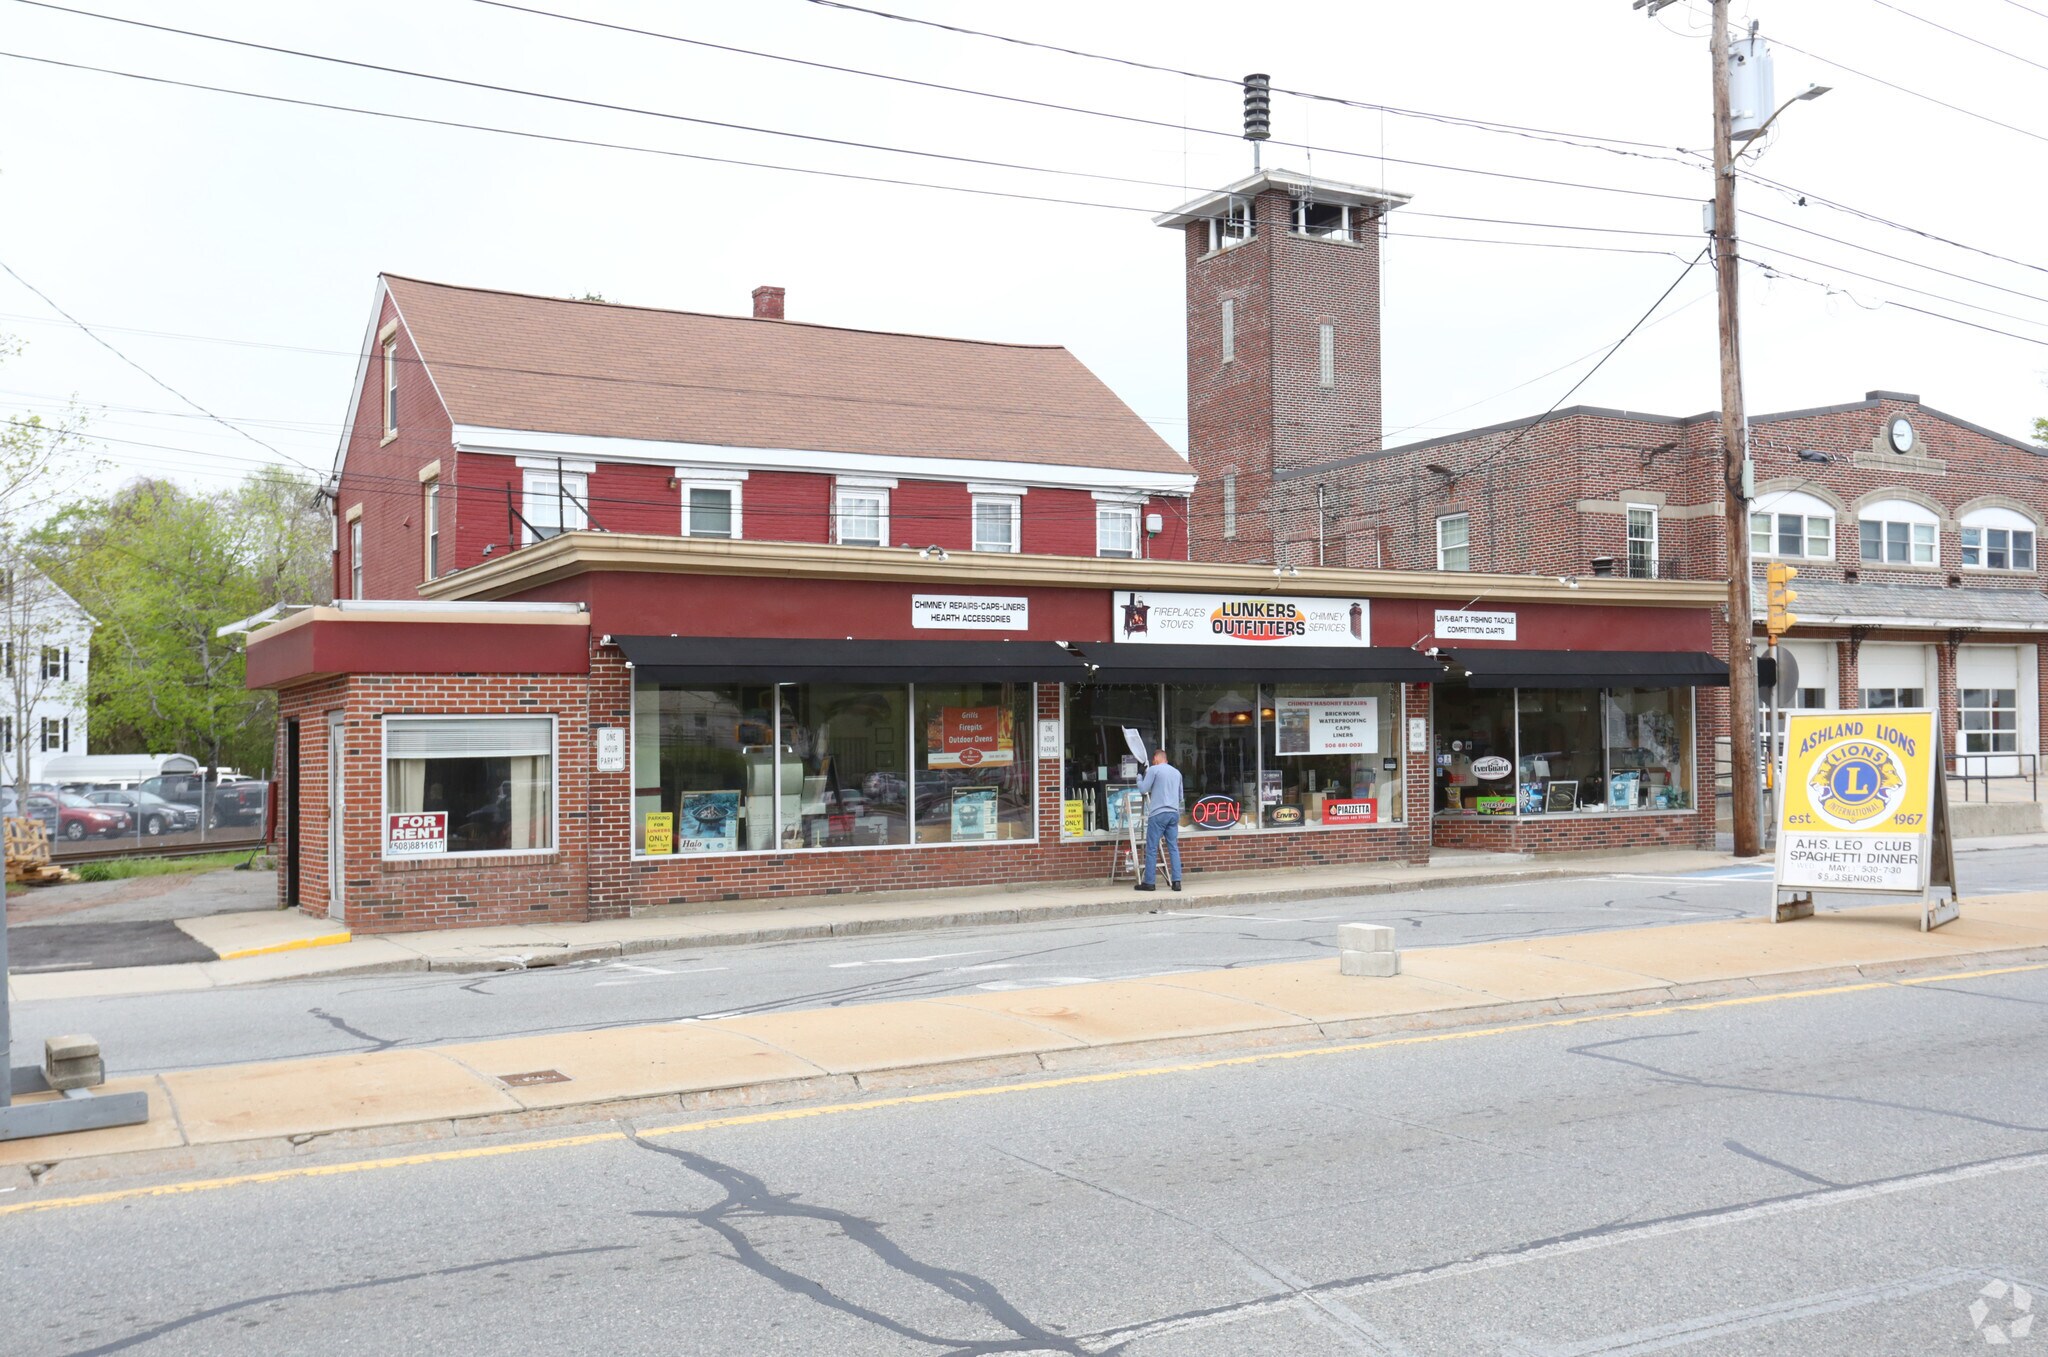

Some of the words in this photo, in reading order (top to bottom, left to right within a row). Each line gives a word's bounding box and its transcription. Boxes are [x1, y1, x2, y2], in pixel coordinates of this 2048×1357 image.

[914, 600, 948, 610] CHIMNEY
[1221, 601, 1296, 619] LUNKERS
[930, 613, 961, 622] HEARTH
[961, 614, 1011, 623] ACCESSORIES
[1153, 606, 1206, 618] FIREPLACES
[1309, 611, 1345, 621] CHIMNEY
[1159, 618, 1194, 629] STOVES
[1211, 619, 1306, 636] OUTFITTERS
[1308, 622, 1346, 632] SERVICES
[1446, 626, 1484, 634] COMPETITION
[959, 724, 983, 732] Firepits
[1798, 722, 1864, 759] ASHLAND
[1876, 724, 1916, 758] LIONS
[1832, 745, 1884, 763] LIONS
[1844, 766, 1869, 795] L
[1192, 802, 1240, 823] OPEN
[1276, 810, 1298, 819] Enviro
[1337, 804, 1370, 814] PIAZZETTA
[1828, 802, 1881, 817] INTERNATIONAL
[398, 816, 436, 828] FOR
[1788, 812, 1816, 824] est.
[1893, 813, 1924, 826] 1967
[392, 827, 443, 840] RENT
[1835, 840, 1863, 851] LEO
[1874, 840, 1912, 852] CLUB
[1790, 850, 1861, 864] SPAGHETTI
[1866, 853, 1918, 864] DINNER
[1841, 874, 1883, 883] SENIORS
